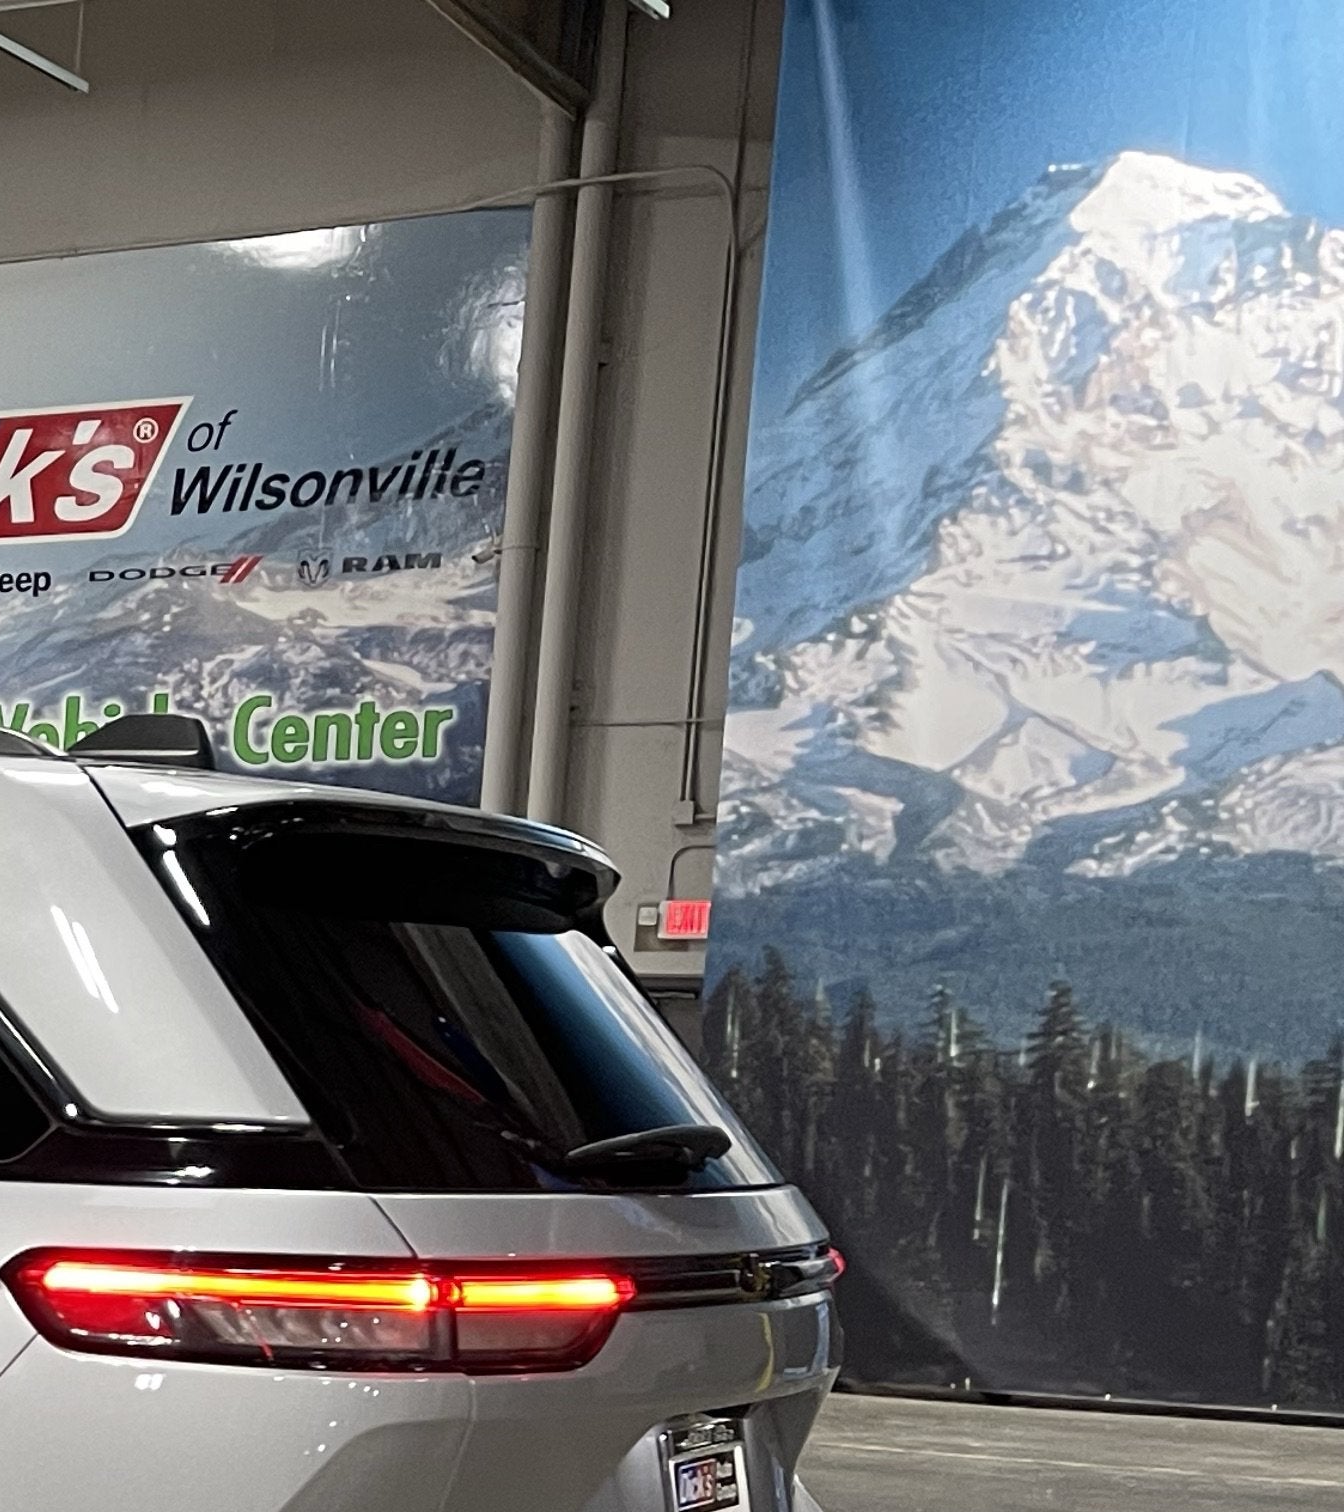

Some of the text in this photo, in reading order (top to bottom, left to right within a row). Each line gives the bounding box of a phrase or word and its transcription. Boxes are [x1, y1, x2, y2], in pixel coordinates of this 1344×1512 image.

[186, 408, 239, 453] of
[170, 447, 486, 516] Wilsonville
[87, 562, 235, 584] DODGE
[341, 551, 443, 574] RAM
[232, 694, 454, 765] Center
